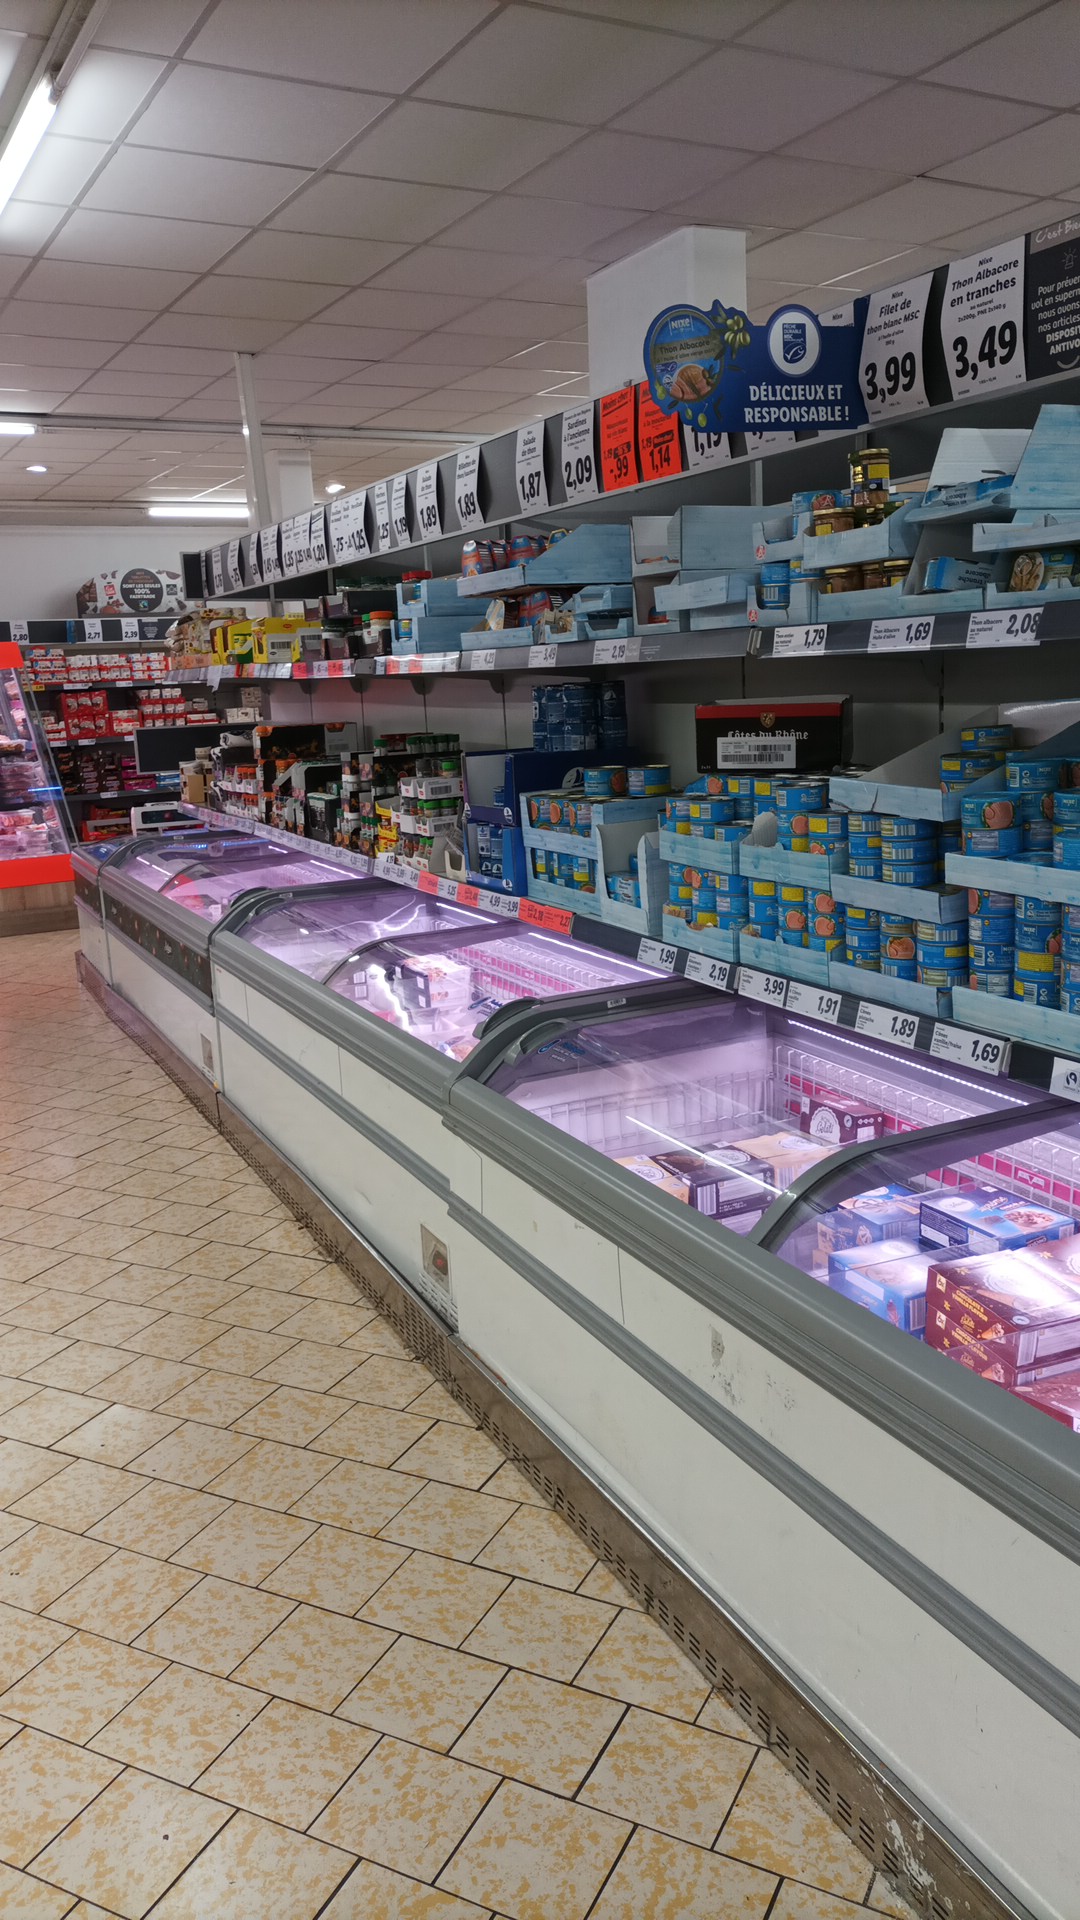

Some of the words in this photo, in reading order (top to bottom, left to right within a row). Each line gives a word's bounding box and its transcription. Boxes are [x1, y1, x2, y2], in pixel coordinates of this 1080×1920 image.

[978, 256, 993, 267] Nixe
[951, 276, 973, 291] Thon
[975, 259, 1019, 283] Albacore
[950, 296, 963, 308] en
[966, 277, 1017, 303] tranches
[1037, 283, 1055, 296] Pour
[879, 303, 898, 318] Filet
[900, 298, 912, 311] de
[1031, 297, 1043, 311] vol
[1045, 297, 1053, 307] en
[867, 323, 882, 336] thon
[883, 317, 902, 331] blanc
[903, 310, 920, 324] MSC
[1038, 308, 1055, 321] nous
[1038, 321, 1051, 333] nos
[1053, 313, 1080, 329] articles
[659, 345, 678, 355] Thon
[679, 340, 710, 351] Albacore
[952, 320, 1017, 381] 3,49
[864, 351, 916, 404] 3,99
[749, 382, 825, 402] DÉLICIEUX
[828, 384, 843, 400] ET
[567, 418, 587, 431] Sardines
[744, 406, 842, 423] RESPONSABLE
[845, 406, 849, 422] !
[649, 443, 671, 472] 1,14
[564, 455, 592, 491] 2,09
[519, 470, 542, 503] 1,87
[457, 491, 476, 521] 1,89
[420, 504, 437, 531] 1,89
[124, 631, 138, 639] 2,39
[905, 621, 931, 644] 1,69
[1006, 612, 1041, 638] 2,08
[12, 633, 28, 641] 2,80
[87, 632, 101, 640] 2,71
[804, 628, 825, 649] 1,79
[611, 643, 626, 660] 2,19
[775, 728, 809, 741] Rhône
[489, 895, 501, 908] 4,99
[507, 900, 519, 913] 3,99
[659, 947, 676, 965] 1,99
[708, 963, 728, 982] 2,19
[763, 977, 785, 996] 3,99
[817, 995, 839, 1016] 1,91
[890, 1015, 916, 1039] 1,89
[934, 1030, 948, 1039] Cônes
[970, 1039, 1000, 1064] 1,69
